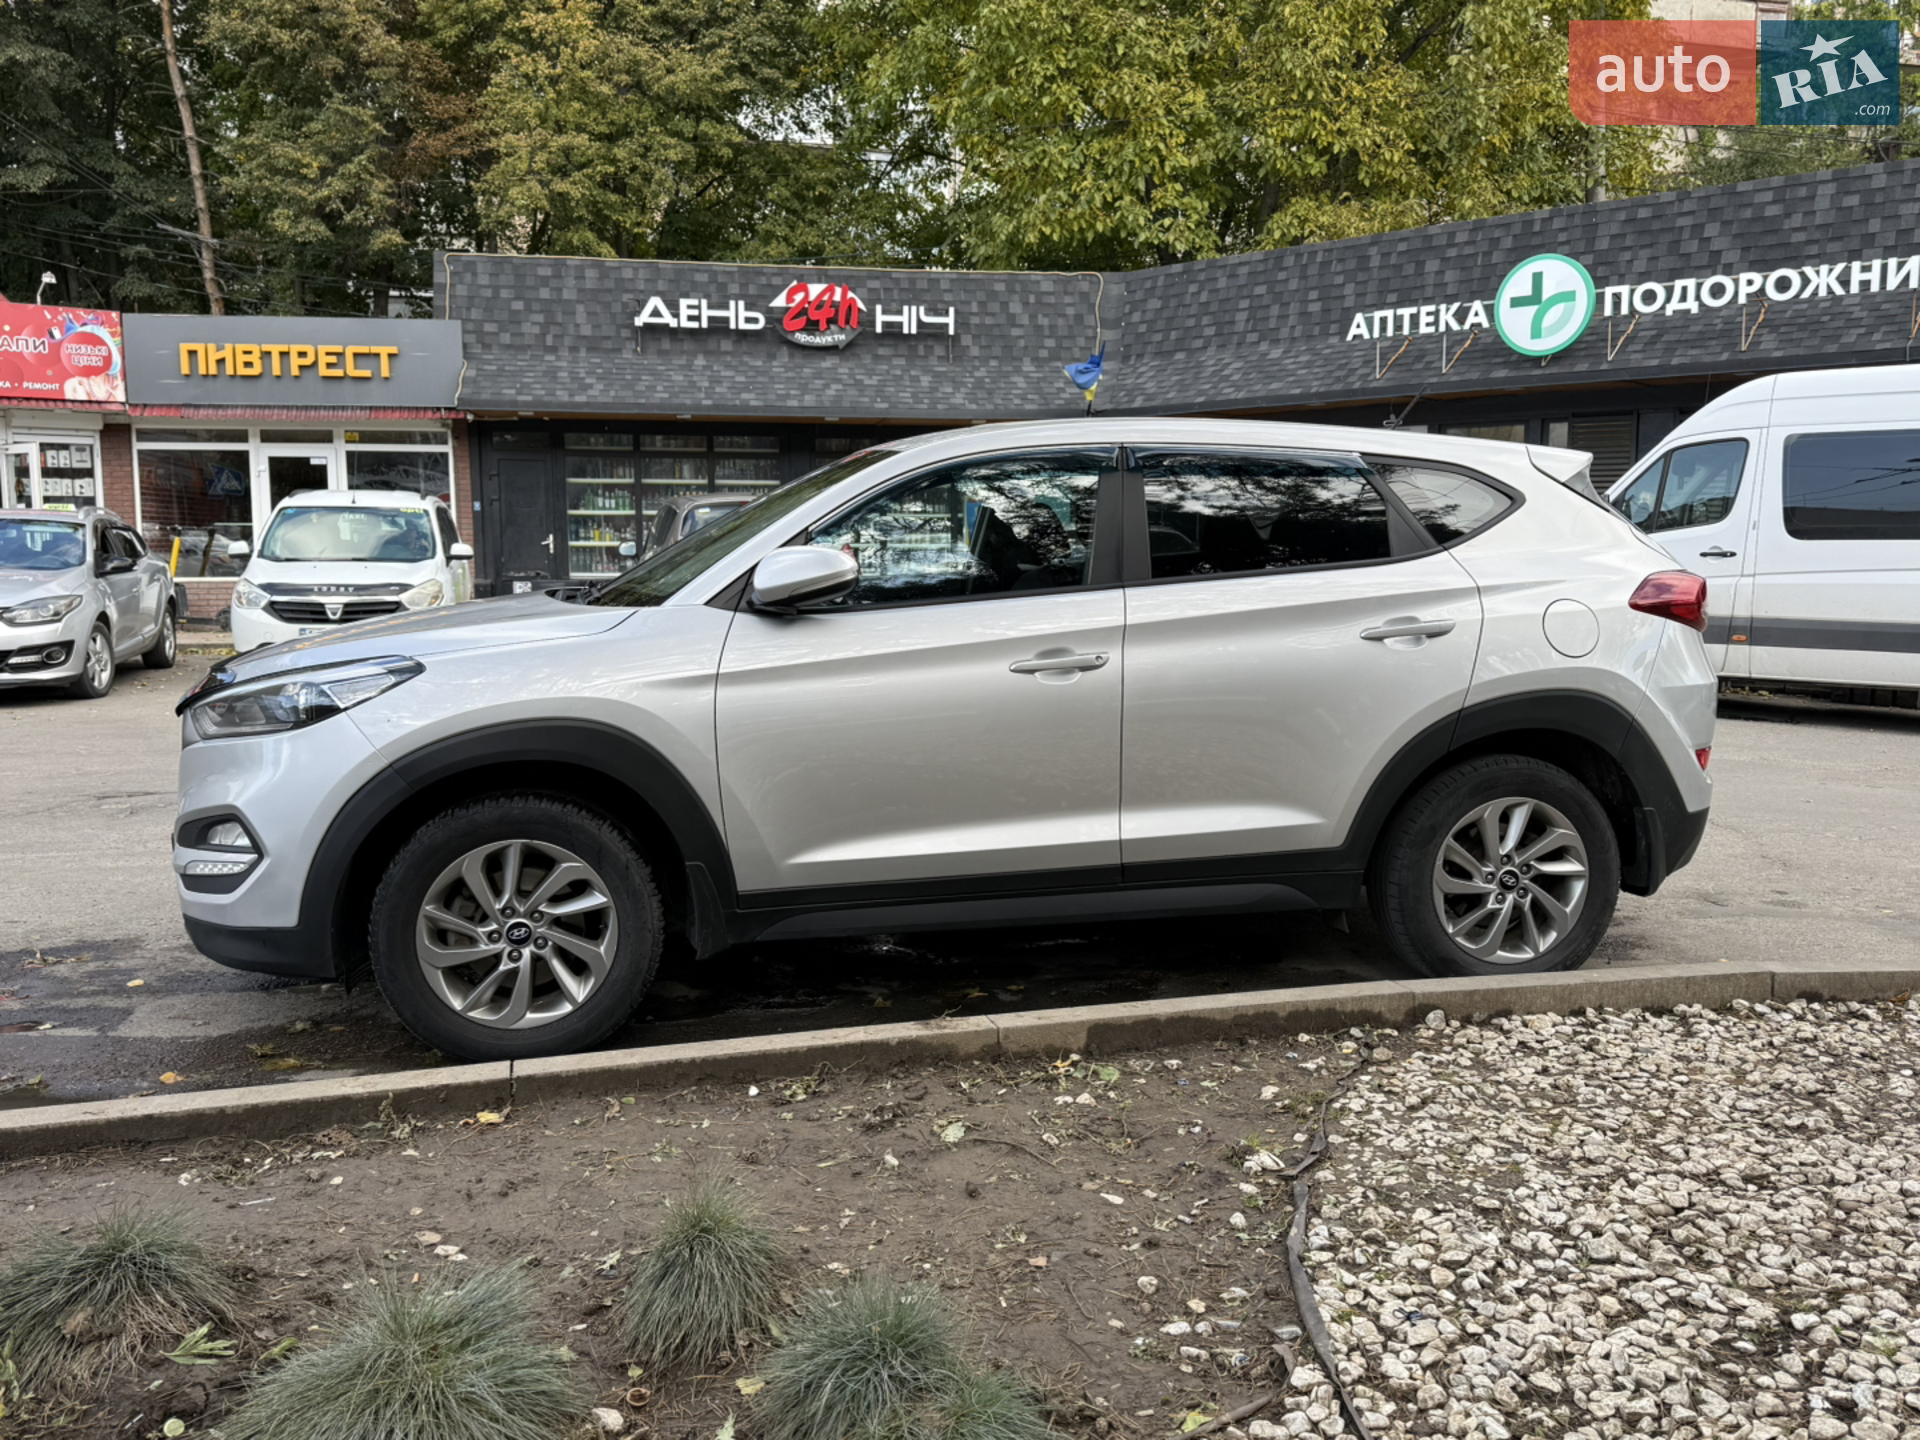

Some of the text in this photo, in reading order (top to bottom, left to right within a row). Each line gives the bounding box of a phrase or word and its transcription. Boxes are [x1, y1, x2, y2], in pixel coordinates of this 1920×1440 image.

[634, 282, 955, 335] ДЕНЬ 24h НІЧ
[1346, 255, 1920, 341] АПТЕКА ПОДОРОЖНИ
[179, 342, 398, 378] ПИВТРЕСТ
[23, 381, 60, 391] РЕМОНТ
